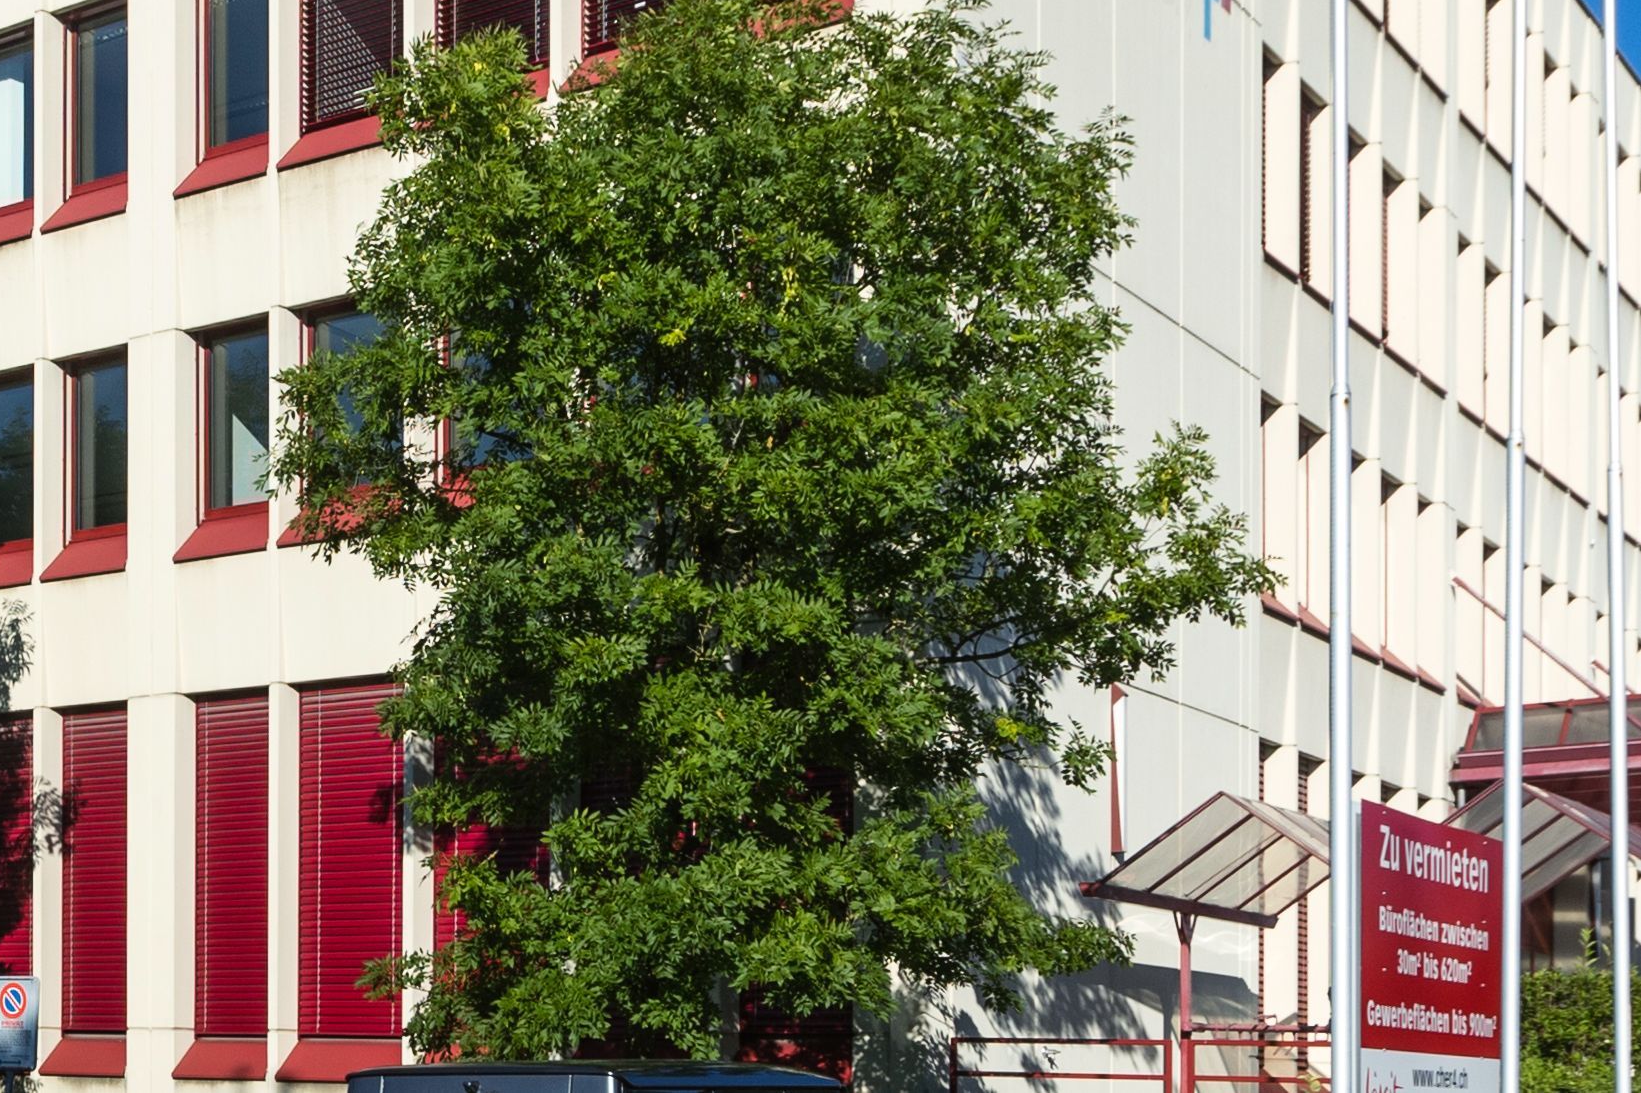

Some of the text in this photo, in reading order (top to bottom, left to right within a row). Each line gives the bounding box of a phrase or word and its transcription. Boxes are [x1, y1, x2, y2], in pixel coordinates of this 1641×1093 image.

[1379, 824, 1489, 894] Zu vermieten
[1378, 905, 1489, 951] Büroflächen zwischen
[1423, 953, 1439, 979] bis
[1366, 1000, 1450, 1034] Gewerbeflächen
[1451, 1008, 1467, 1036] bis
[1412, 1066, 1469, 1089] www.cher4.ch
